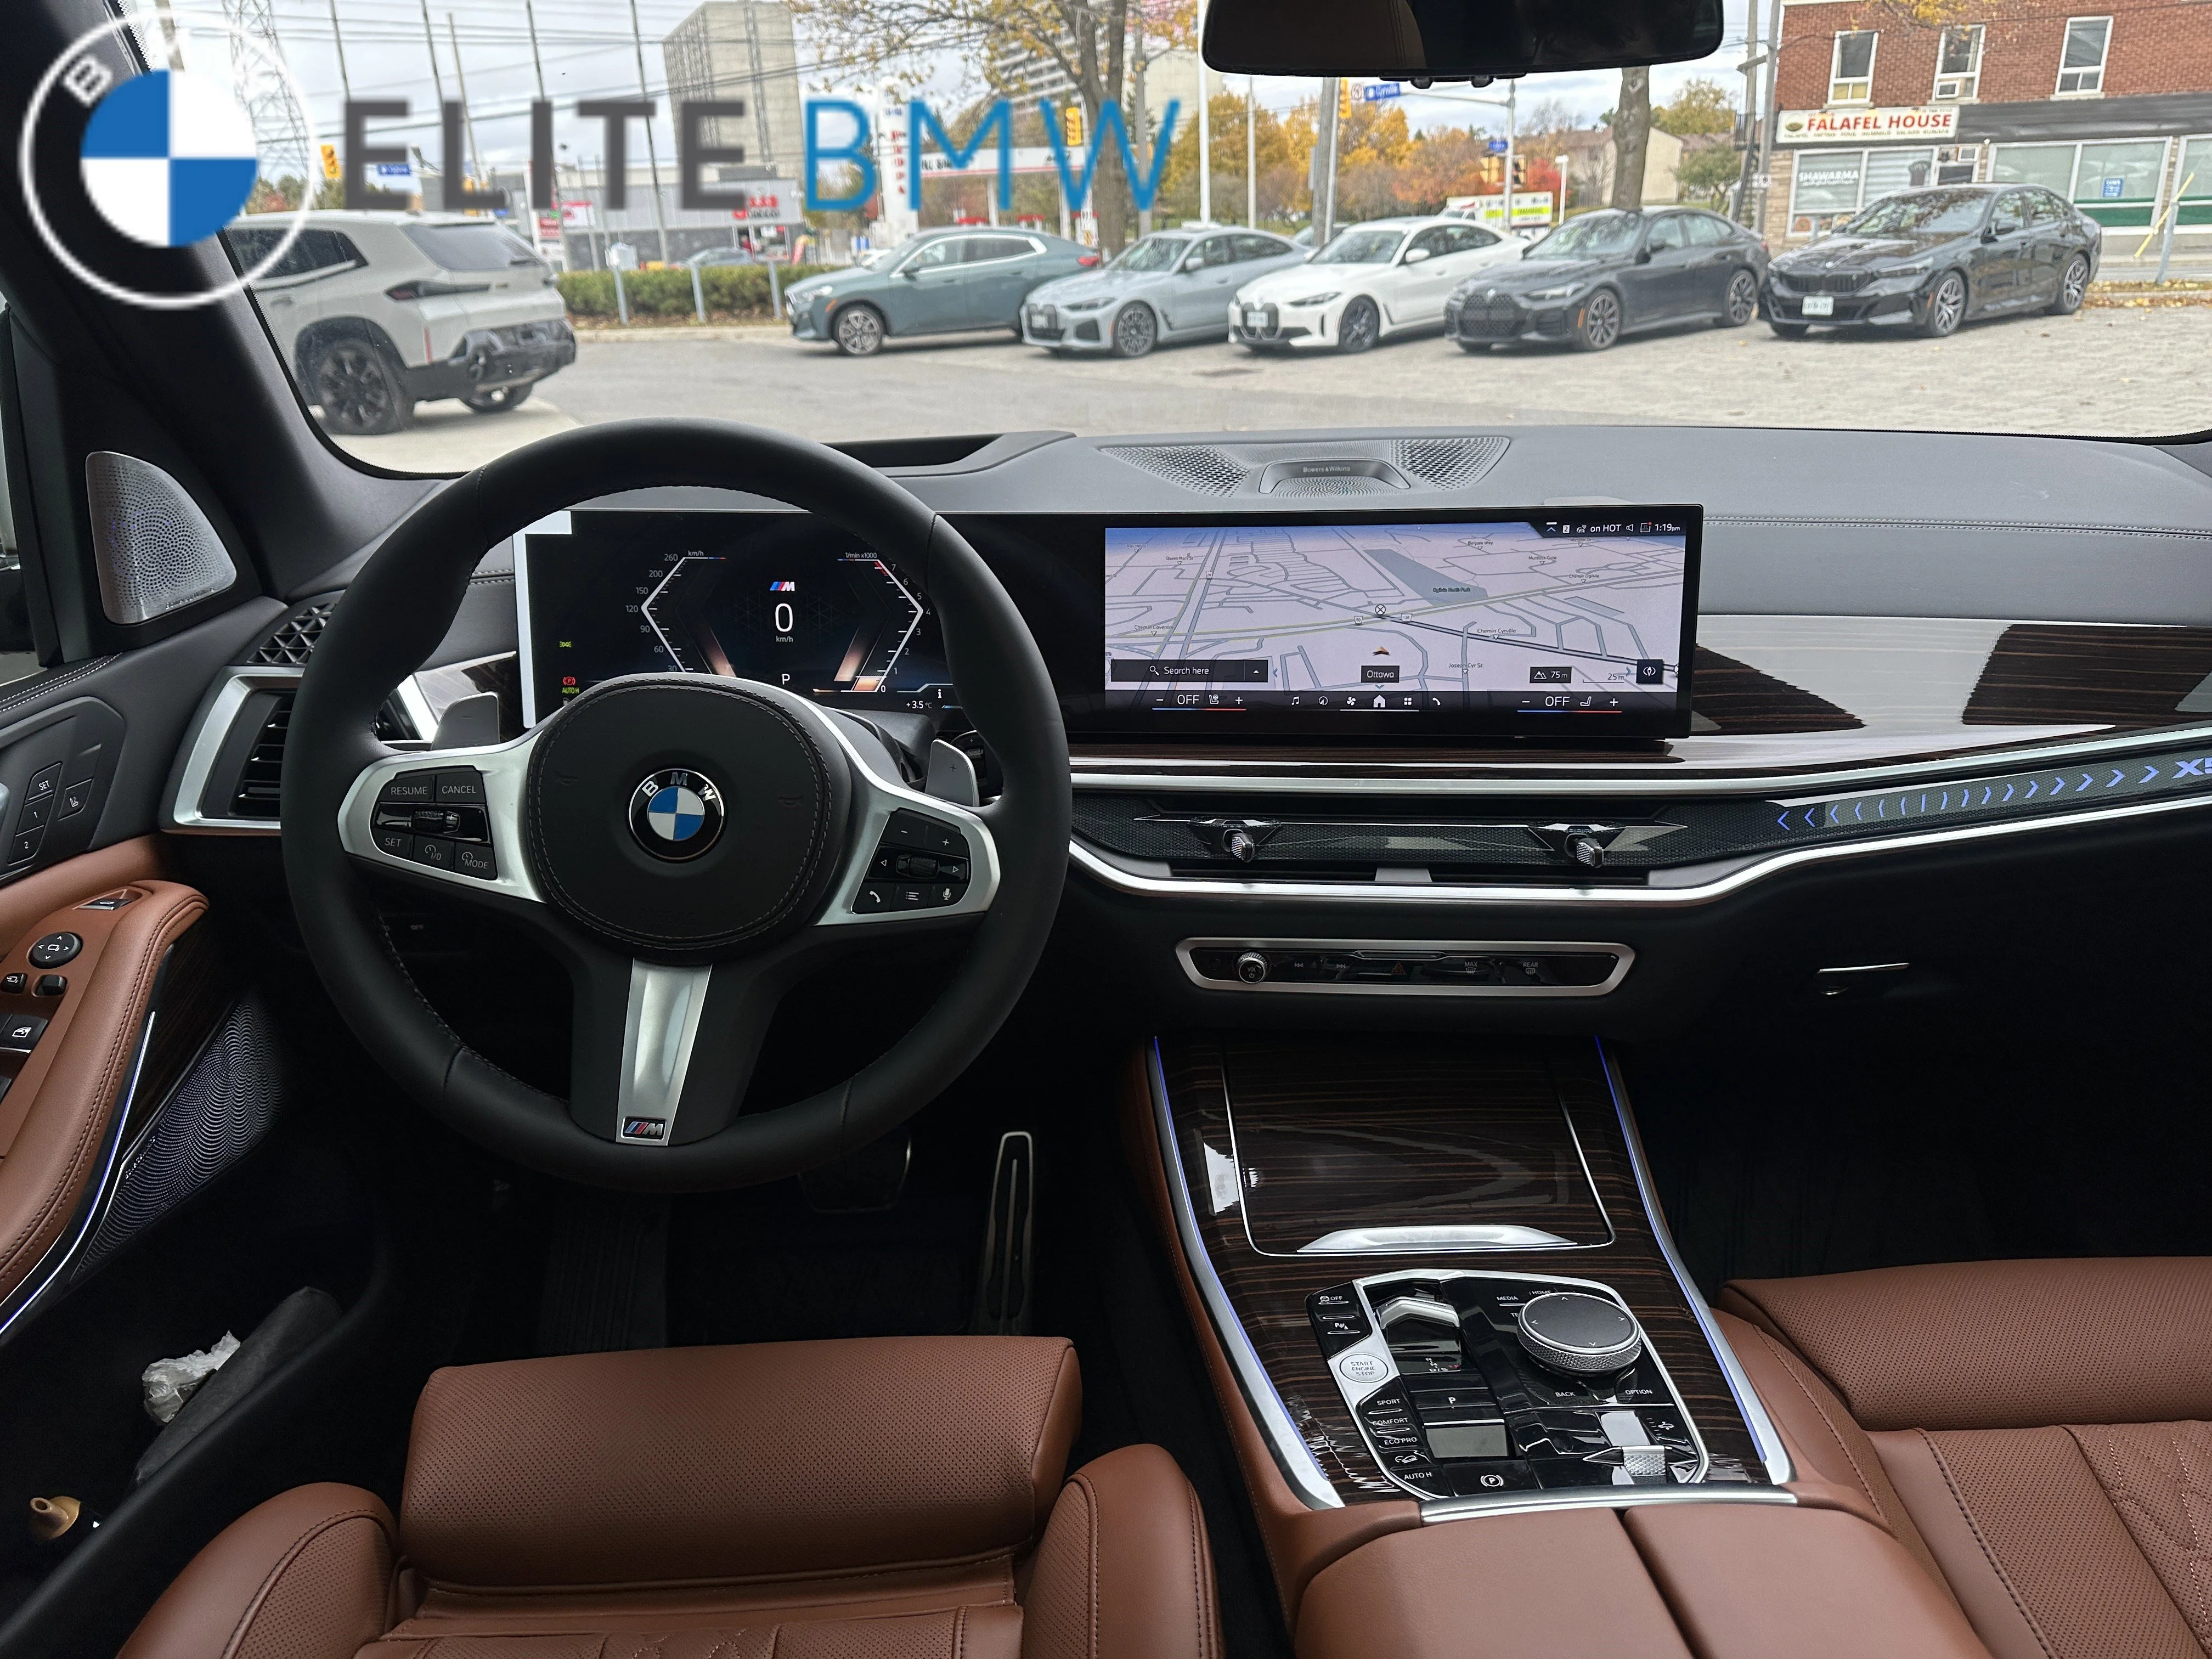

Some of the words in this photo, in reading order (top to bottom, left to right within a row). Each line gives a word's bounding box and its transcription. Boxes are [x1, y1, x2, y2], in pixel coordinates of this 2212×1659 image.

[1808, 116, 1881, 131] FALAFEL
[1888, 114, 1953, 128] HOUSE
[1799, 170, 1859, 182] SHAWARMA
[1603, 524, 1622, 532] HOT
[664, 554, 678, 562] 260
[775, 603, 793, 632] 0
[1367, 670, 1394, 678] Ottawa
[782, 674, 790, 685] P
[881, 685, 886, 693] 0
[1177, 695, 1199, 704] OFF
[1545, 696, 1570, 707] OFF
[38, 780, 50, 791] SET
[391, 786, 428, 795] RESUME
[442, 785, 477, 794] CANCEL
[642, 772, 716, 801] BMW
[24, 841, 29, 849] 2
[385, 837, 402, 847] SET
[464, 859, 489, 869] MODE
[1448, 1396, 1456, 1404] P
[1373, 1417, 1408, 1426] COMFORT
[1404, 1472, 1425, 1480] AUTO
